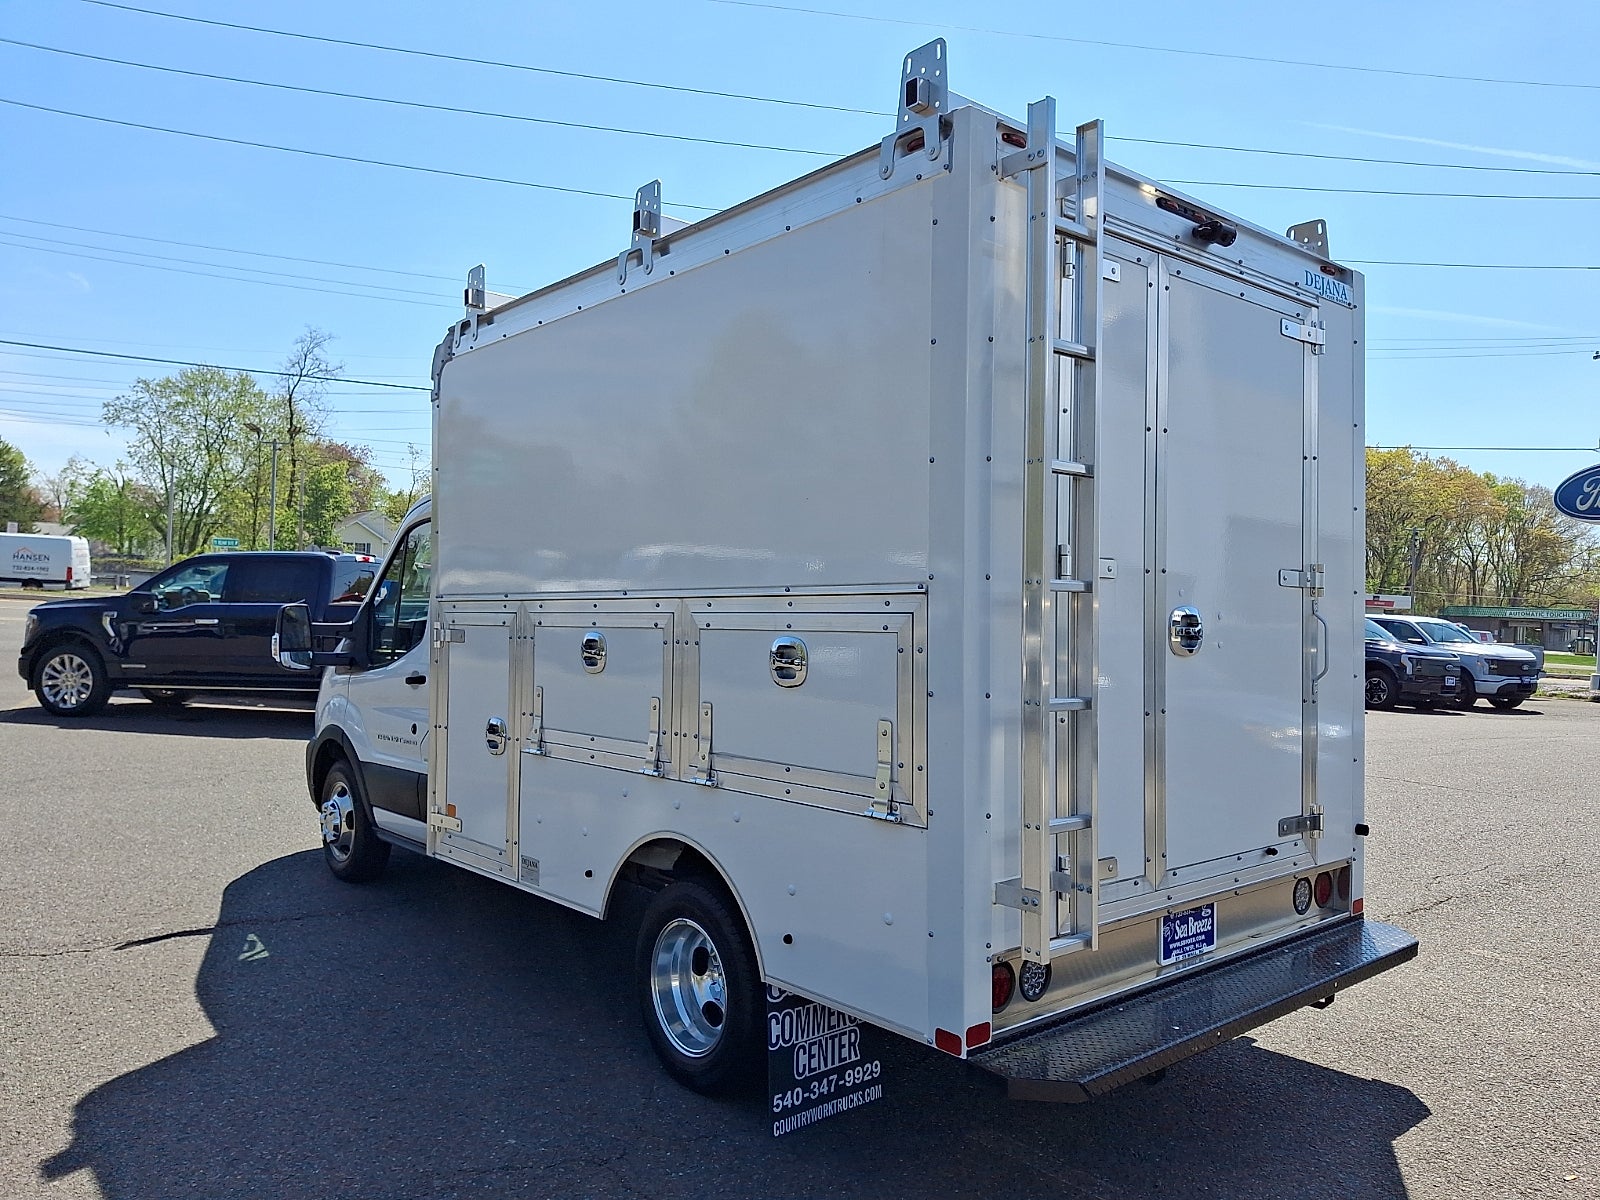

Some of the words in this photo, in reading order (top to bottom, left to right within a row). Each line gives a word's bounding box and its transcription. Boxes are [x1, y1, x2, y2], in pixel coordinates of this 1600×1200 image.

[1304, 270, 1348, 300] DEJANA
[12, 552, 50, 561] HANSEN
[1174, 919, 1188, 940] Sea
[1188, 916, 1212, 936] Breeze
[794, 1026, 860, 1080] CENTER
[772, 1060, 881, 1113] 540-347-9929
[773, 1084, 882, 1137] COUNTRYWORKTRUCKS.COM
